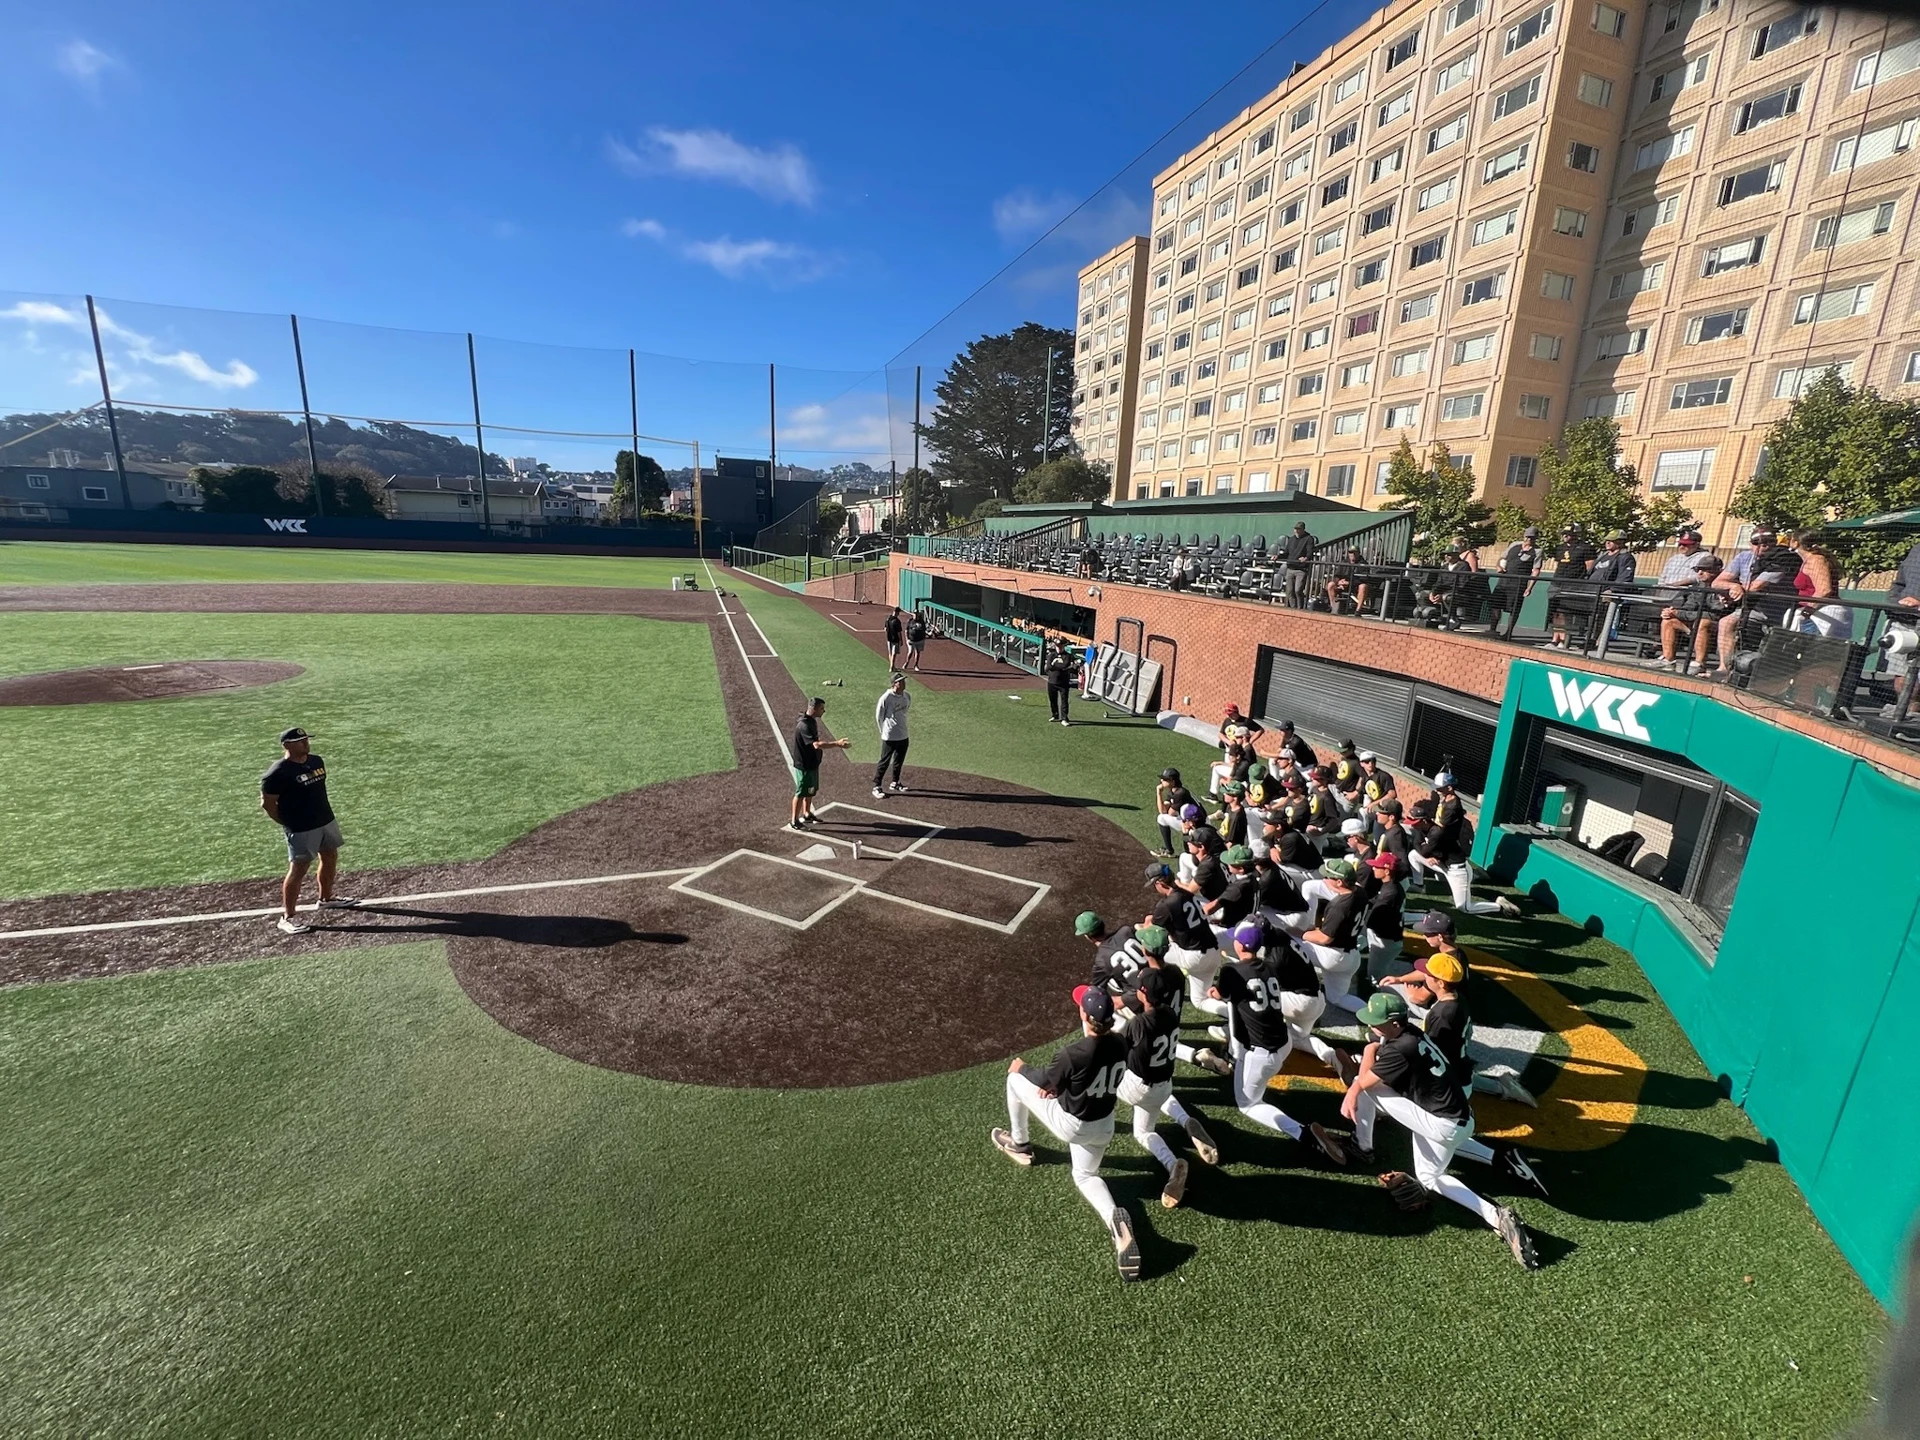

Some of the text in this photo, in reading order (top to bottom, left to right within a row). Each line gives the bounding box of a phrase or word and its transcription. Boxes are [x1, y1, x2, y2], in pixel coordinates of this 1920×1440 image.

[263, 518, 308, 533] WCC
[1547, 671, 1662, 742] WCC
[1110, 938, 1149, 979] 30
[1246, 976, 1281, 1012] 39
[1418, 1032, 1451, 1077] 3
[1086, 1060, 1127, 1098] 40
